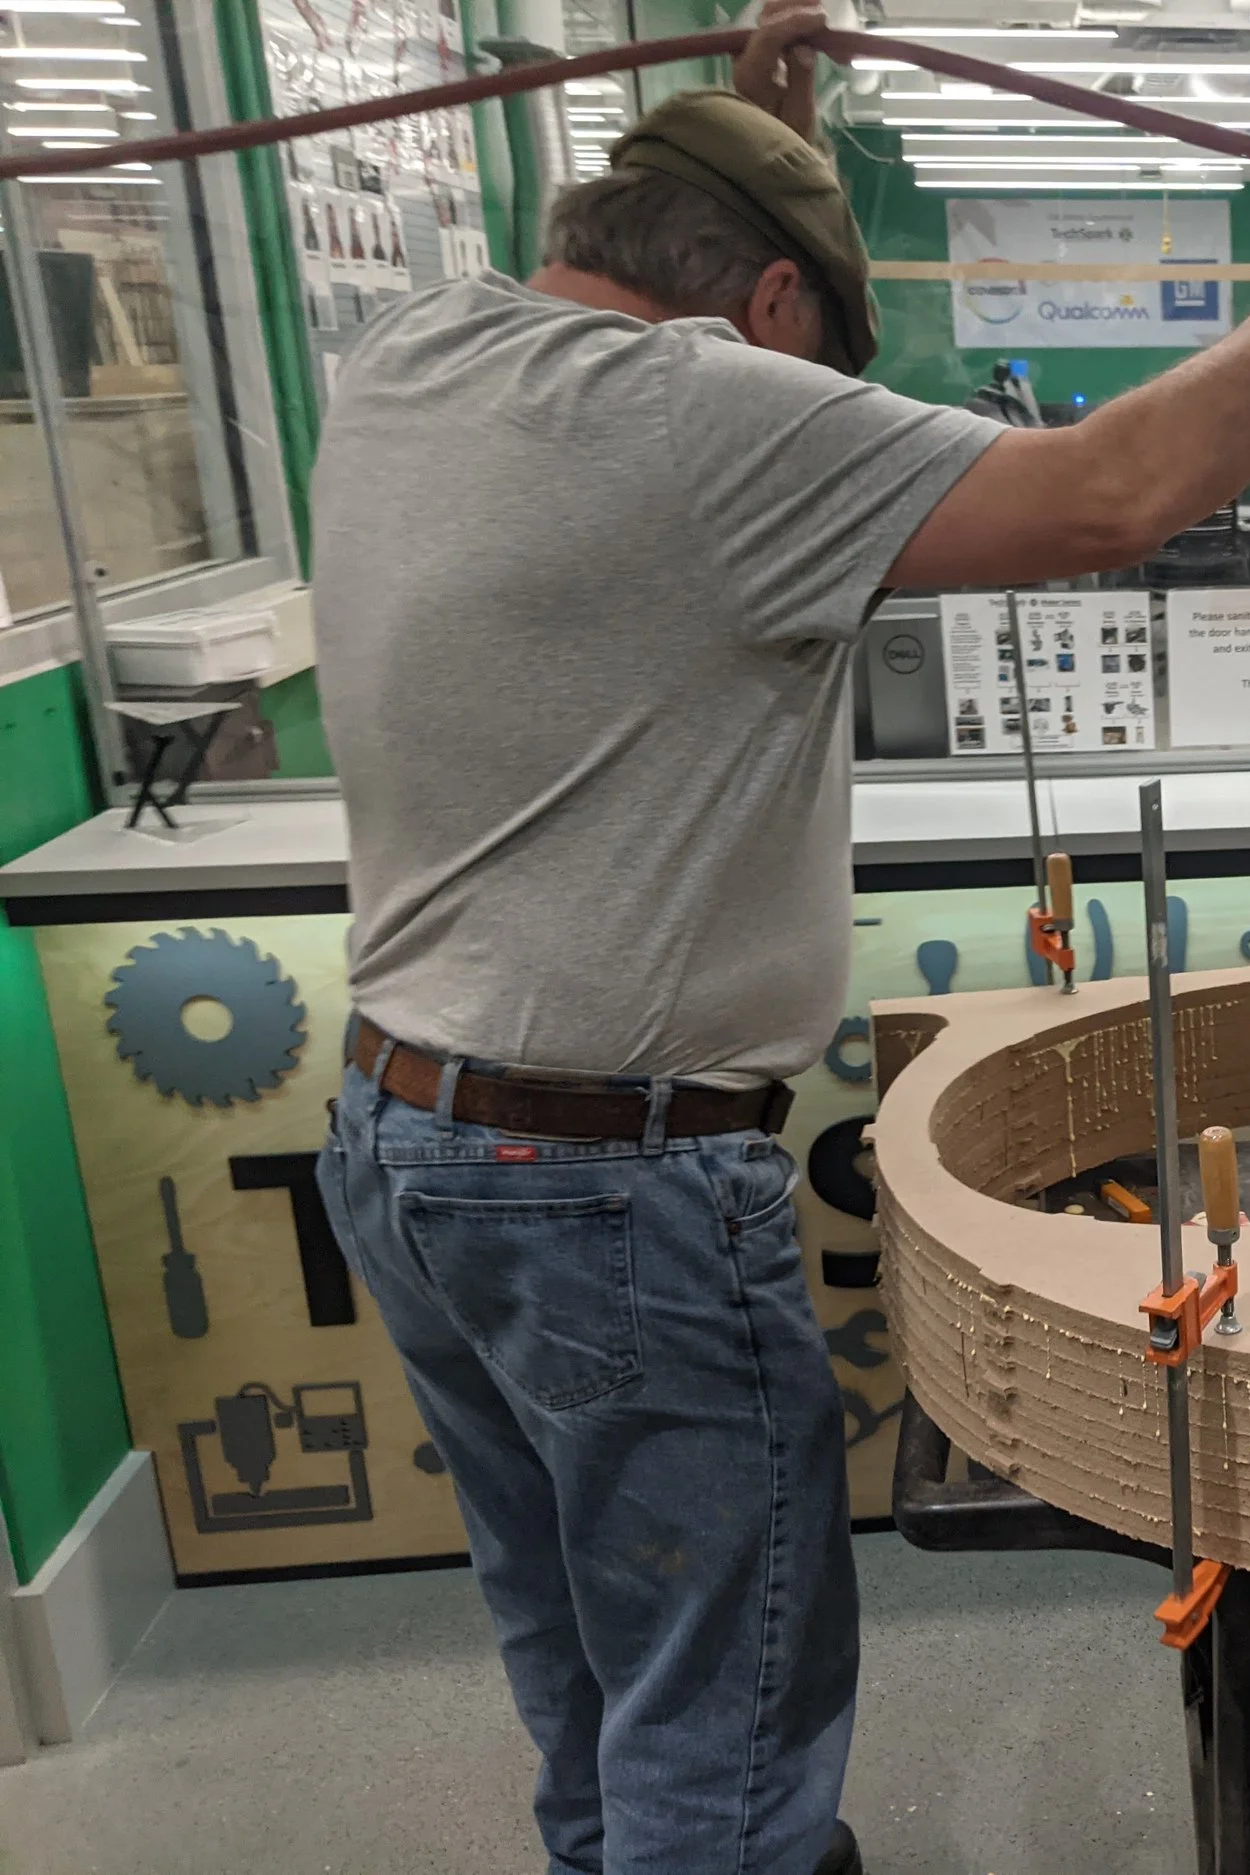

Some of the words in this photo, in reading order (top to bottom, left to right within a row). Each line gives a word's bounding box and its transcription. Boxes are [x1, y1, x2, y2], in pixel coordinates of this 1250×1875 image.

[1038, 301, 1150, 322] Qualcomm
[1192, 612, 1224, 621] Please
[1188, 628, 1206, 637] the
[1208, 628, 1232, 637] door
[1213, 644, 1232, 653] and
